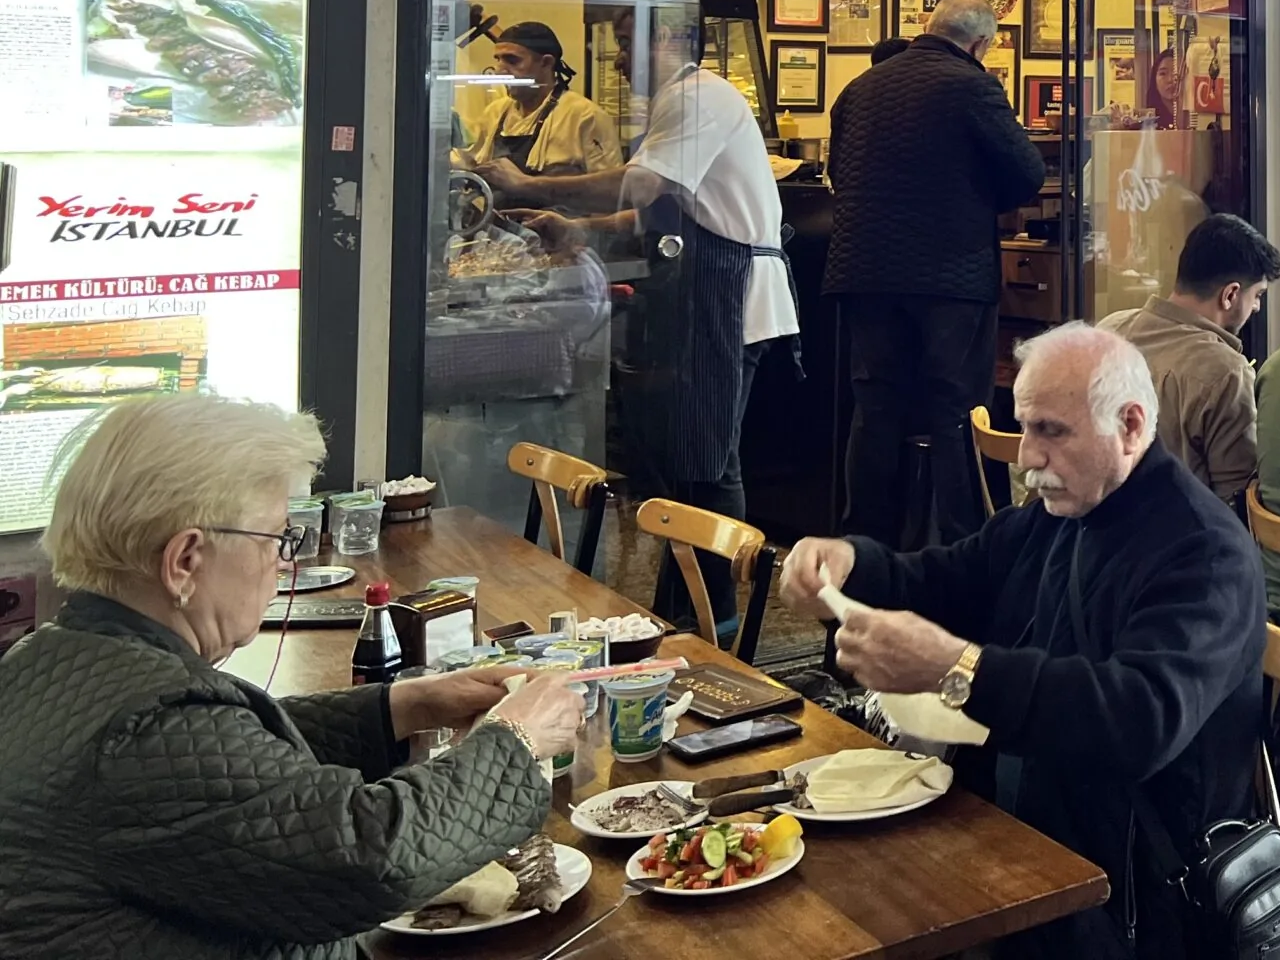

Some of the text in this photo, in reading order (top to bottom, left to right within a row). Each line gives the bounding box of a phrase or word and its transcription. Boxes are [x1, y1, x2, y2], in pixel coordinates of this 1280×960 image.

[37, 193, 259, 218] Yerim Seni
[64, 277, 163, 298] KÜLTÜRÜ:
[169, 274, 208, 292] CAĞ
[215, 273, 280, 291] KEBAP
